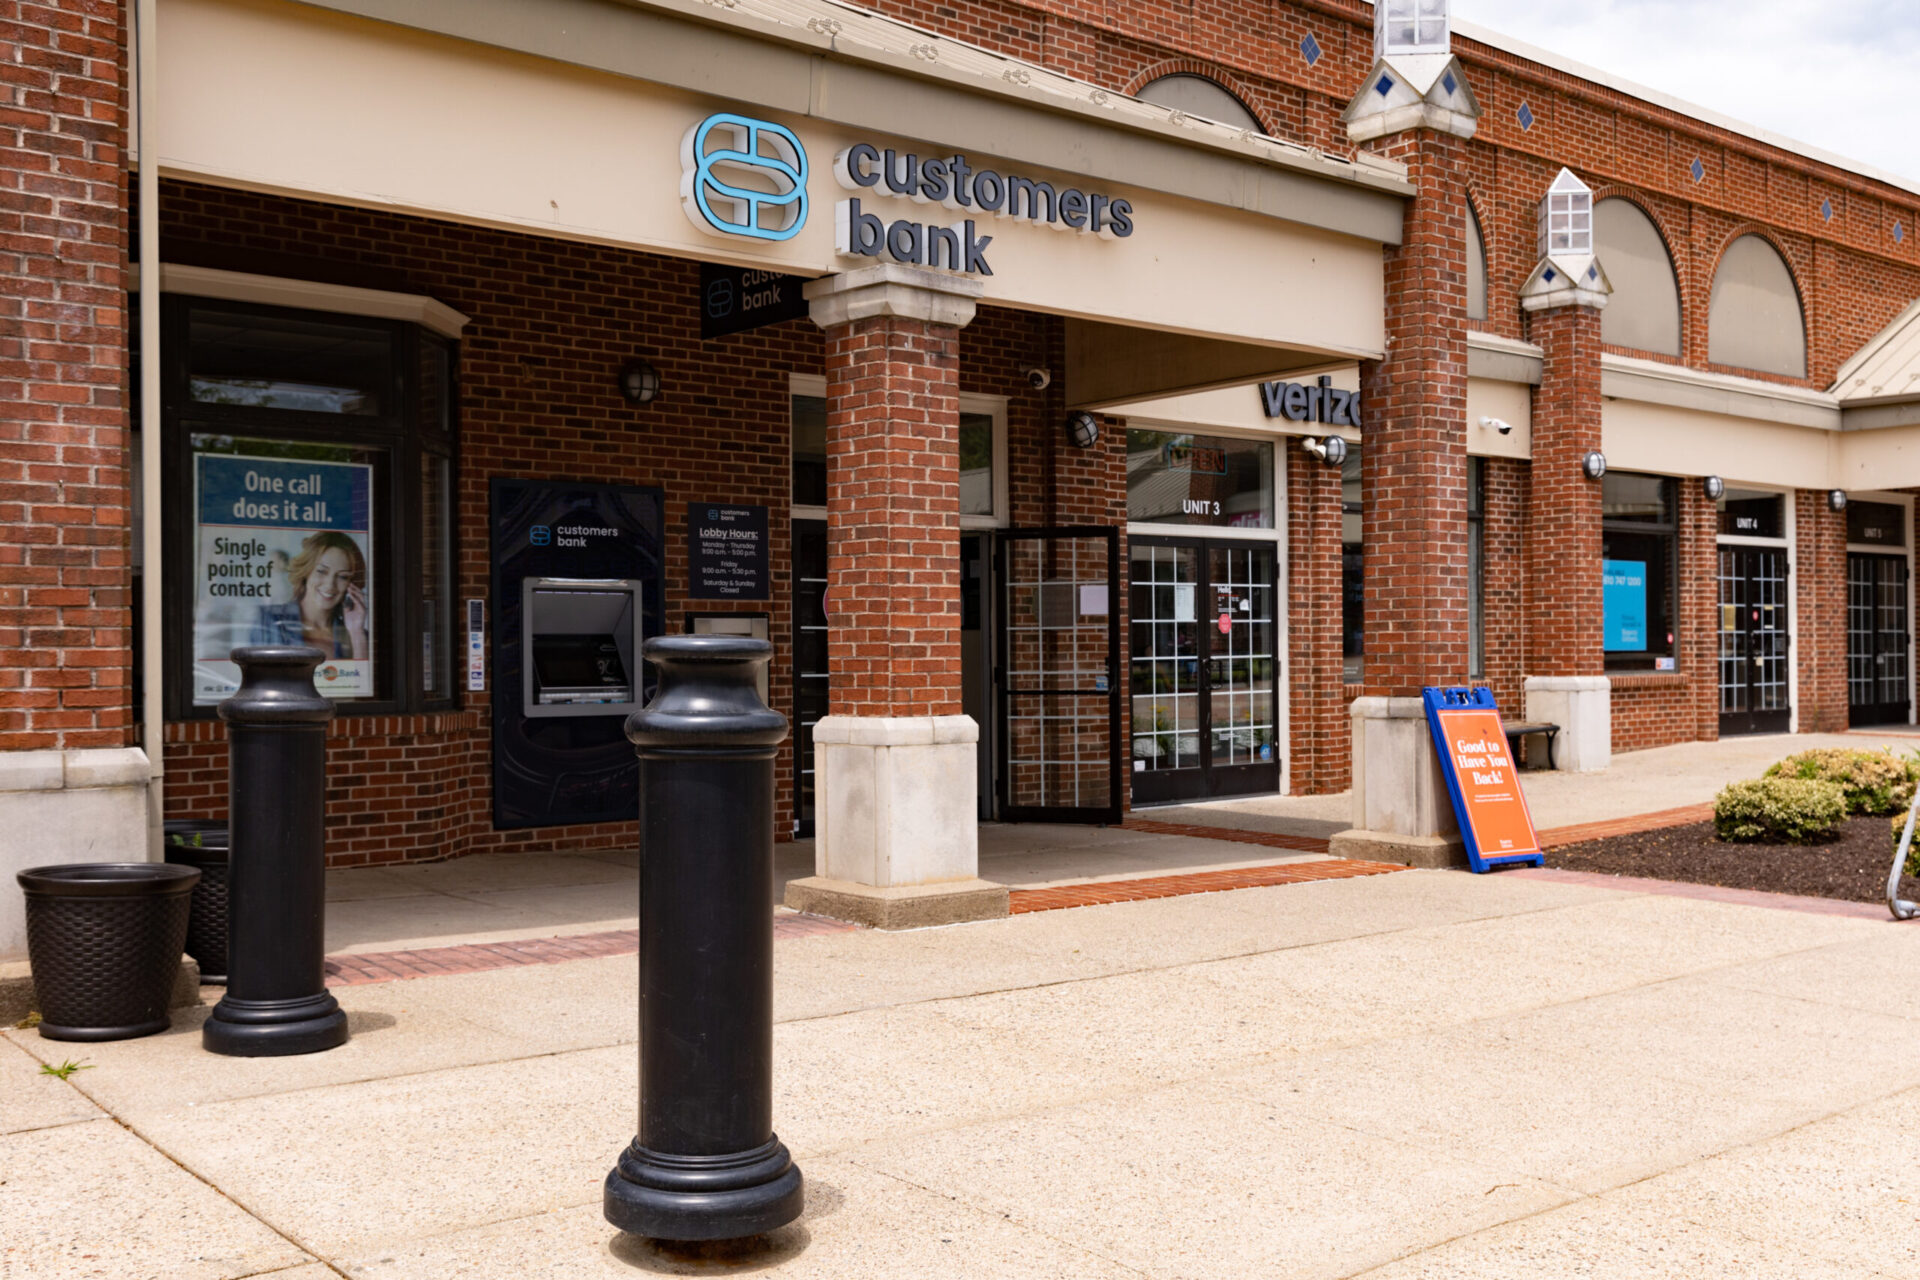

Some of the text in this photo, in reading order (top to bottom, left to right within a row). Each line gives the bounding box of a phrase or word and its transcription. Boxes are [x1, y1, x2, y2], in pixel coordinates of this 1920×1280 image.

[846, 143, 1133, 238] customers
[848, 197, 993, 276] bank
[742, 284, 781, 311] bank
[245, 470, 321, 496] One call
[233, 497, 333, 523] does it all.
[1183, 499, 1221, 516] UNIT 3
[557, 524, 619, 537] customers
[1736, 517, 1758, 529] UNIT 4
[699, 528, 759, 540] Lobby Hours:
[214, 537, 266, 560] Single
[557, 536, 588, 548] bank
[730, 542, 756, 550] Thursday
[208, 560, 273, 582] point of
[720, 561, 738, 569] Friday
[209, 581, 272, 598] contact
[703, 580, 728, 588] Saturday
[735, 580, 756, 588] Sunday
[1457, 739, 1500, 754] Good to
[1457, 753, 1508, 768] Have You
[1472, 771, 1504, 785] Back!
